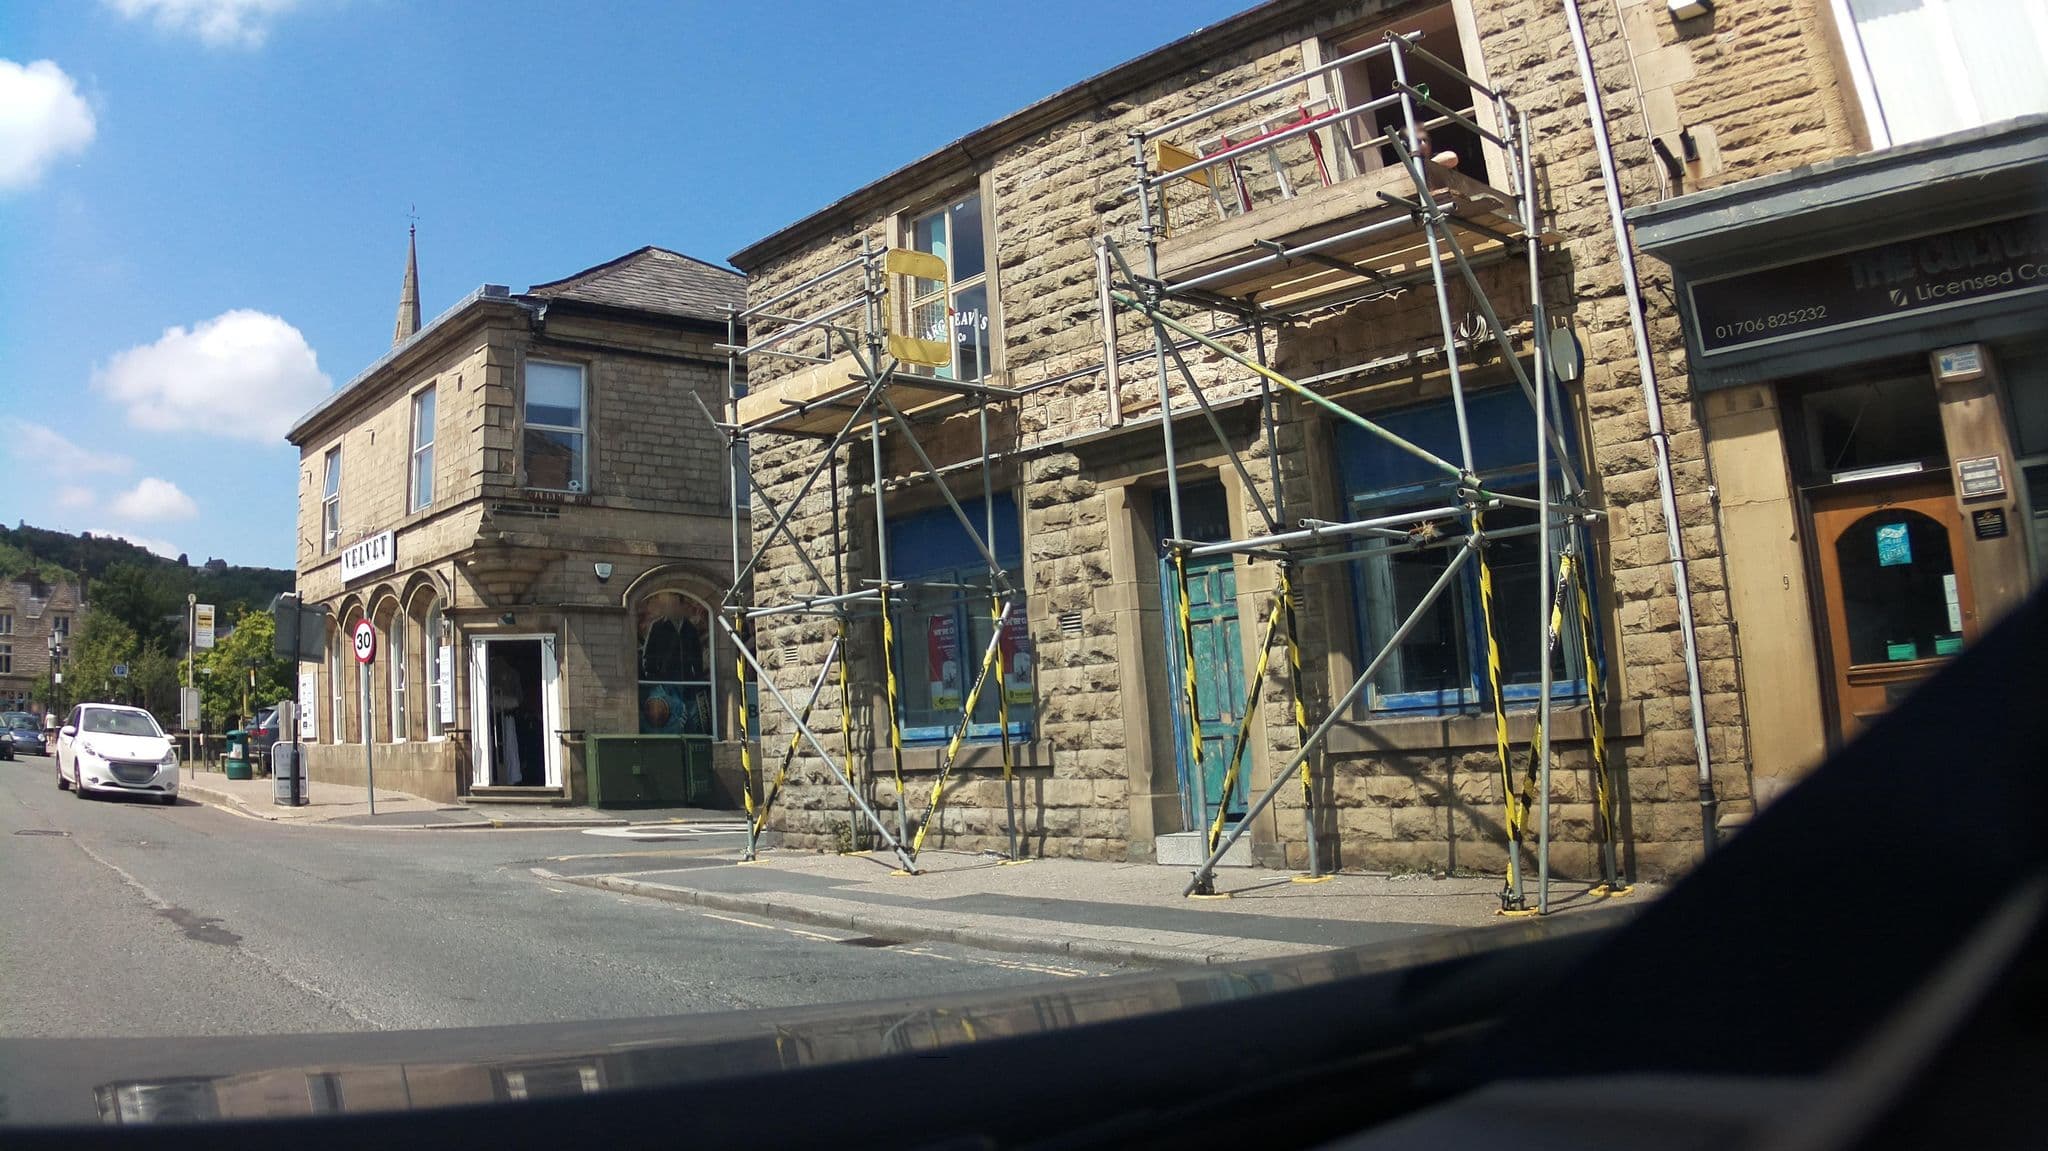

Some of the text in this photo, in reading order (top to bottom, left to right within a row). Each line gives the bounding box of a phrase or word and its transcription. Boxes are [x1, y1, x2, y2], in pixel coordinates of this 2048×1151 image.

[1913, 268, 2015, 301] Licensed
[1715, 305, 1828, 339] 01706 825232
[344, 535, 388, 569] VELVET
[356, 631, 371, 651] 30
